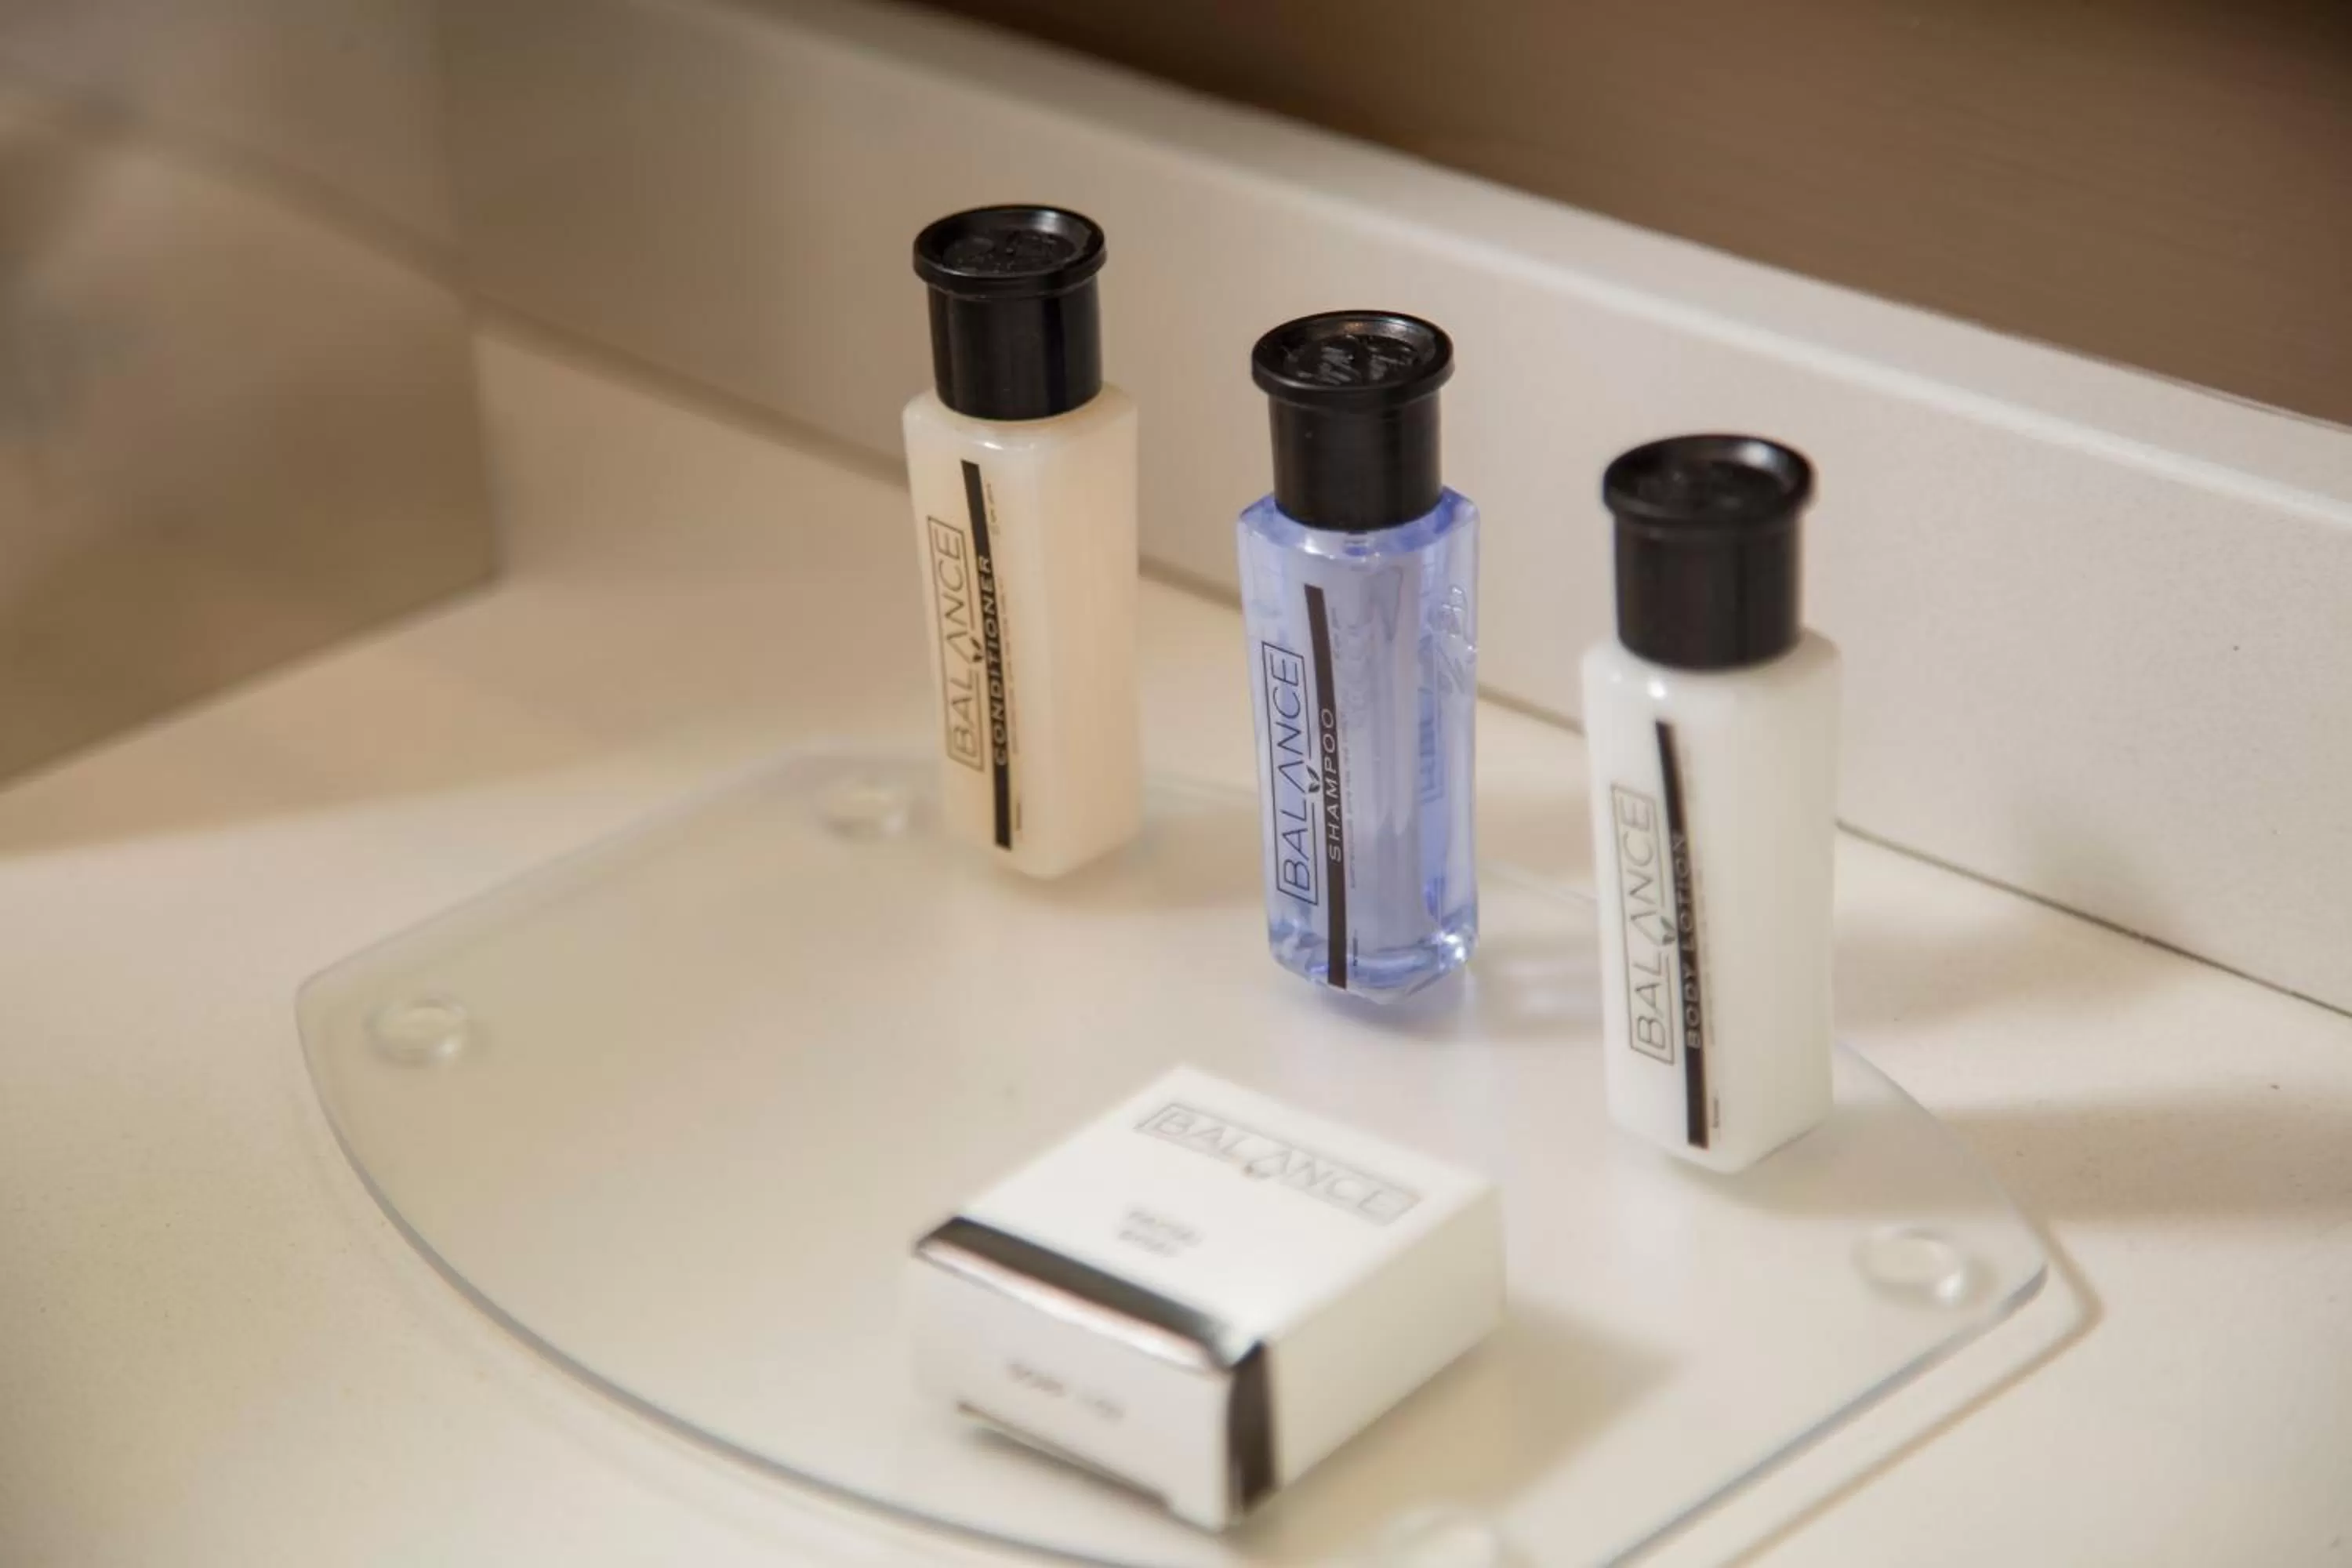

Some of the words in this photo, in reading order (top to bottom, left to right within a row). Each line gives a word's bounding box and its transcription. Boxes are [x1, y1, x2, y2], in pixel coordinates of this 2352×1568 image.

[933, 528, 978, 758] BALANCE
[978, 556, 1006, 766] CONDITIONER
[1270, 650, 1311, 891] BALANCE
[1321, 707, 1342, 863] SHAMPOO
[1619, 797, 1667, 1051] BALANCE
[1671, 829, 1695, 954] LOTION
[1682, 963, 1702, 1050] BODY
[1153, 1110, 1402, 1218] BALANCE
